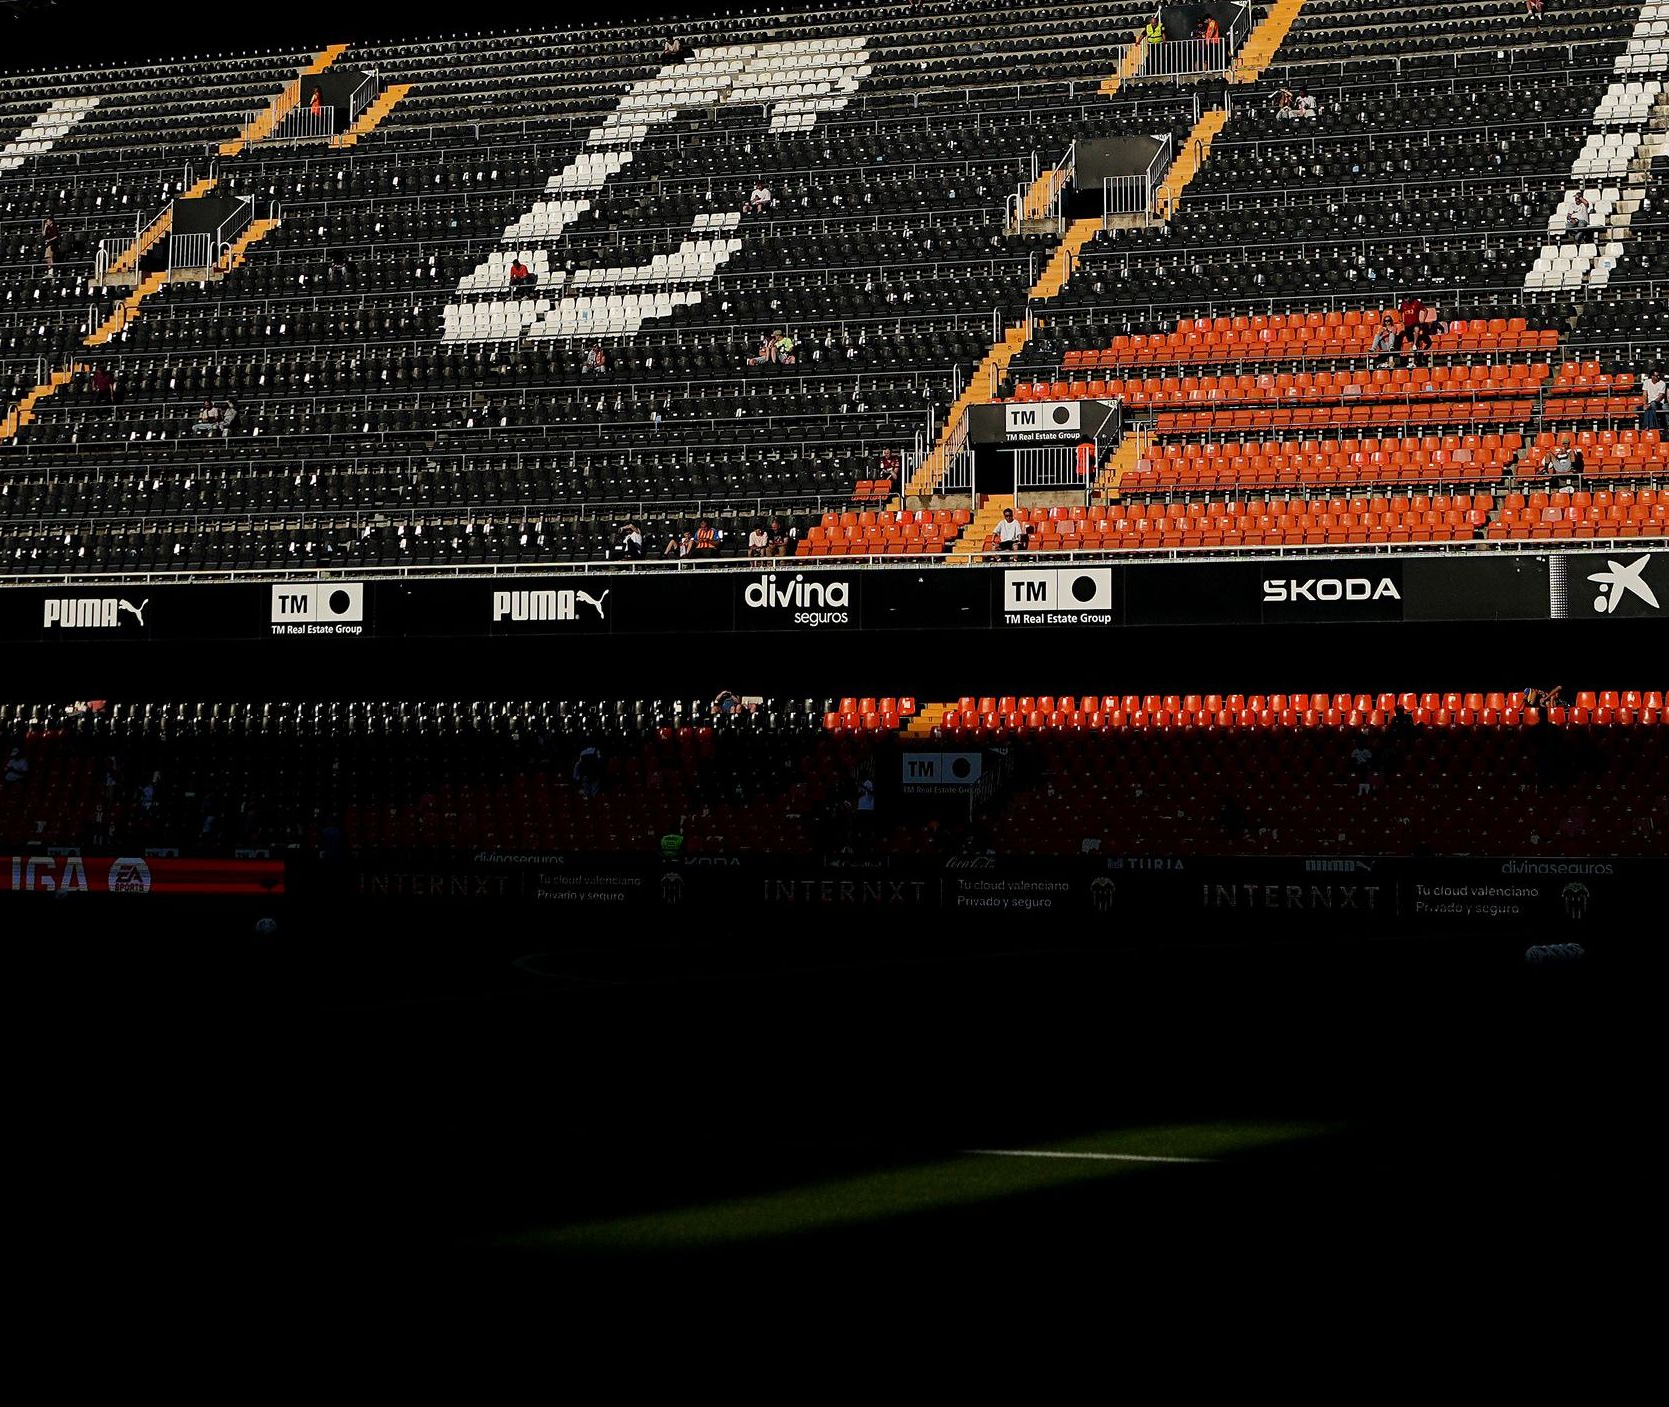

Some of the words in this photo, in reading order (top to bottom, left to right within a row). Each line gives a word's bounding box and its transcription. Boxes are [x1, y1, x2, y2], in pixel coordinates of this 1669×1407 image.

[1011, 411, 1035, 425] TM
[1006, 433, 1018, 441] TM
[1019, 433, 1034, 441] Real
[1035, 432, 1058, 440] Estate
[1058, 431, 1081, 440] Group
[744, 575, 849, 609] divina
[1012, 581, 1046, 602] TM
[1264, 578, 1400, 601] SKODA
[279, 595, 307, 613] TM
[493, 590, 579, 621] PUMA
[44, 598, 121, 628] PUMA
[794, 611, 848, 627] seguros
[1005, 614, 1019, 624] TM
[1022, 613, 1044, 624] Real
[1047, 612, 1078, 623] Estate
[1080, 611, 1112, 625] Group
[271, 625, 285, 634] TM
[286, 625, 303, 634] Real
[306, 624, 332, 634] Estate
[334, 624, 363, 637] Group
[908, 761, 933, 777] TM
[117, 865, 143, 882] EA
[358, 871, 509, 896] INTERNXT
[958, 879, 974, 891] Tu
[976, 878, 1005, 891] cloud
[1006, 878, 1070, 892] valenciano
[1416, 885, 1432, 897] Tu
[1433, 885, 1467, 897] cloud
[1469, 885, 1539, 898] valenciano
[763, 879, 926, 905] INTERNXT
[1201, 884, 1381, 910] INTERNXT
[957, 895, 1000, 907] Privado
[1011, 898, 1052, 910] seguro
[1415, 901, 1463, 914] Privado
[1476, 904, 1520, 916] seguro
